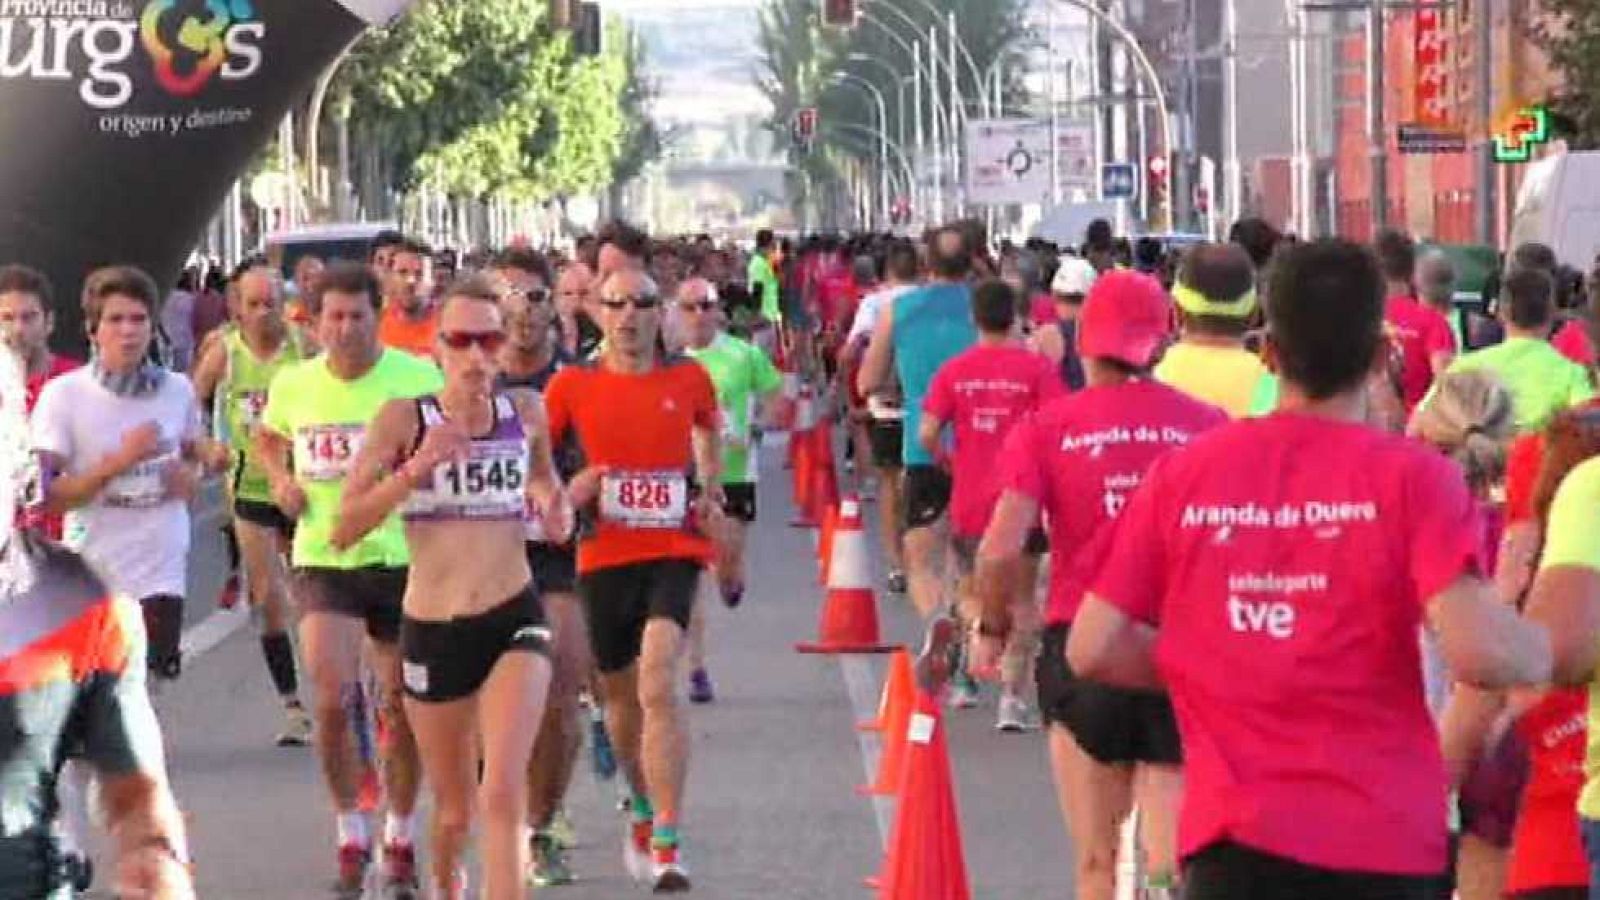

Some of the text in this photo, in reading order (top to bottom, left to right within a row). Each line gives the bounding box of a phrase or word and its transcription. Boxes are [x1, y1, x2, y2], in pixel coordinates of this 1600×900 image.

[0, 4, 265, 109] urgos
[100, 106, 252, 137] origen y destino
[1061, 427, 1189, 453] Aranda de Du
[446, 459, 522, 495] 1545
[619, 480, 671, 509] 826
[1180, 500, 1377, 535] Aranda de Duero
[1227, 595, 1295, 638] tve
